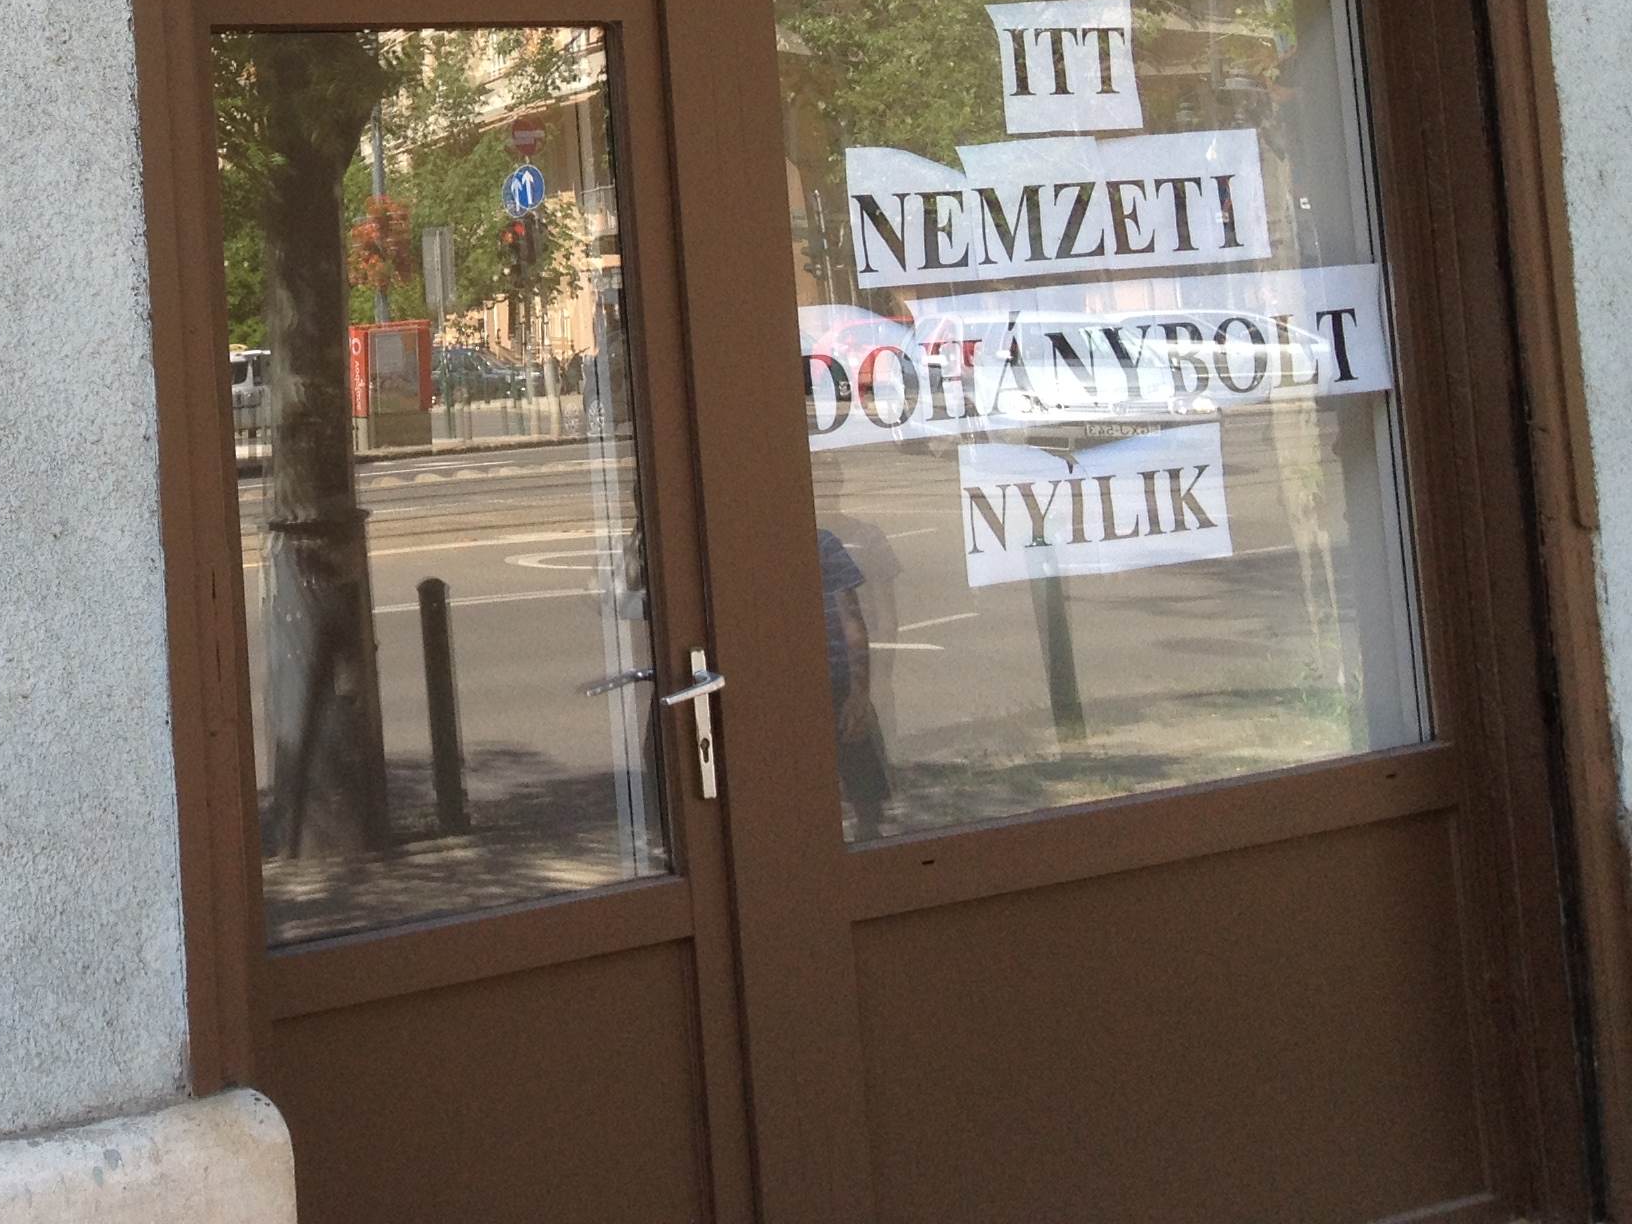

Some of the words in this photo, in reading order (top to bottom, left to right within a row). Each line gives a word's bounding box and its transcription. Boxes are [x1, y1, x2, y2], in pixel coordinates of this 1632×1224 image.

[1003, 27, 1125, 97] ITT
[851, 174, 1244, 273] NEMZETI
[801, 308, 1358, 436] DOHÁNYBOLT
[963, 460, 1219, 554] NYÍLIK
